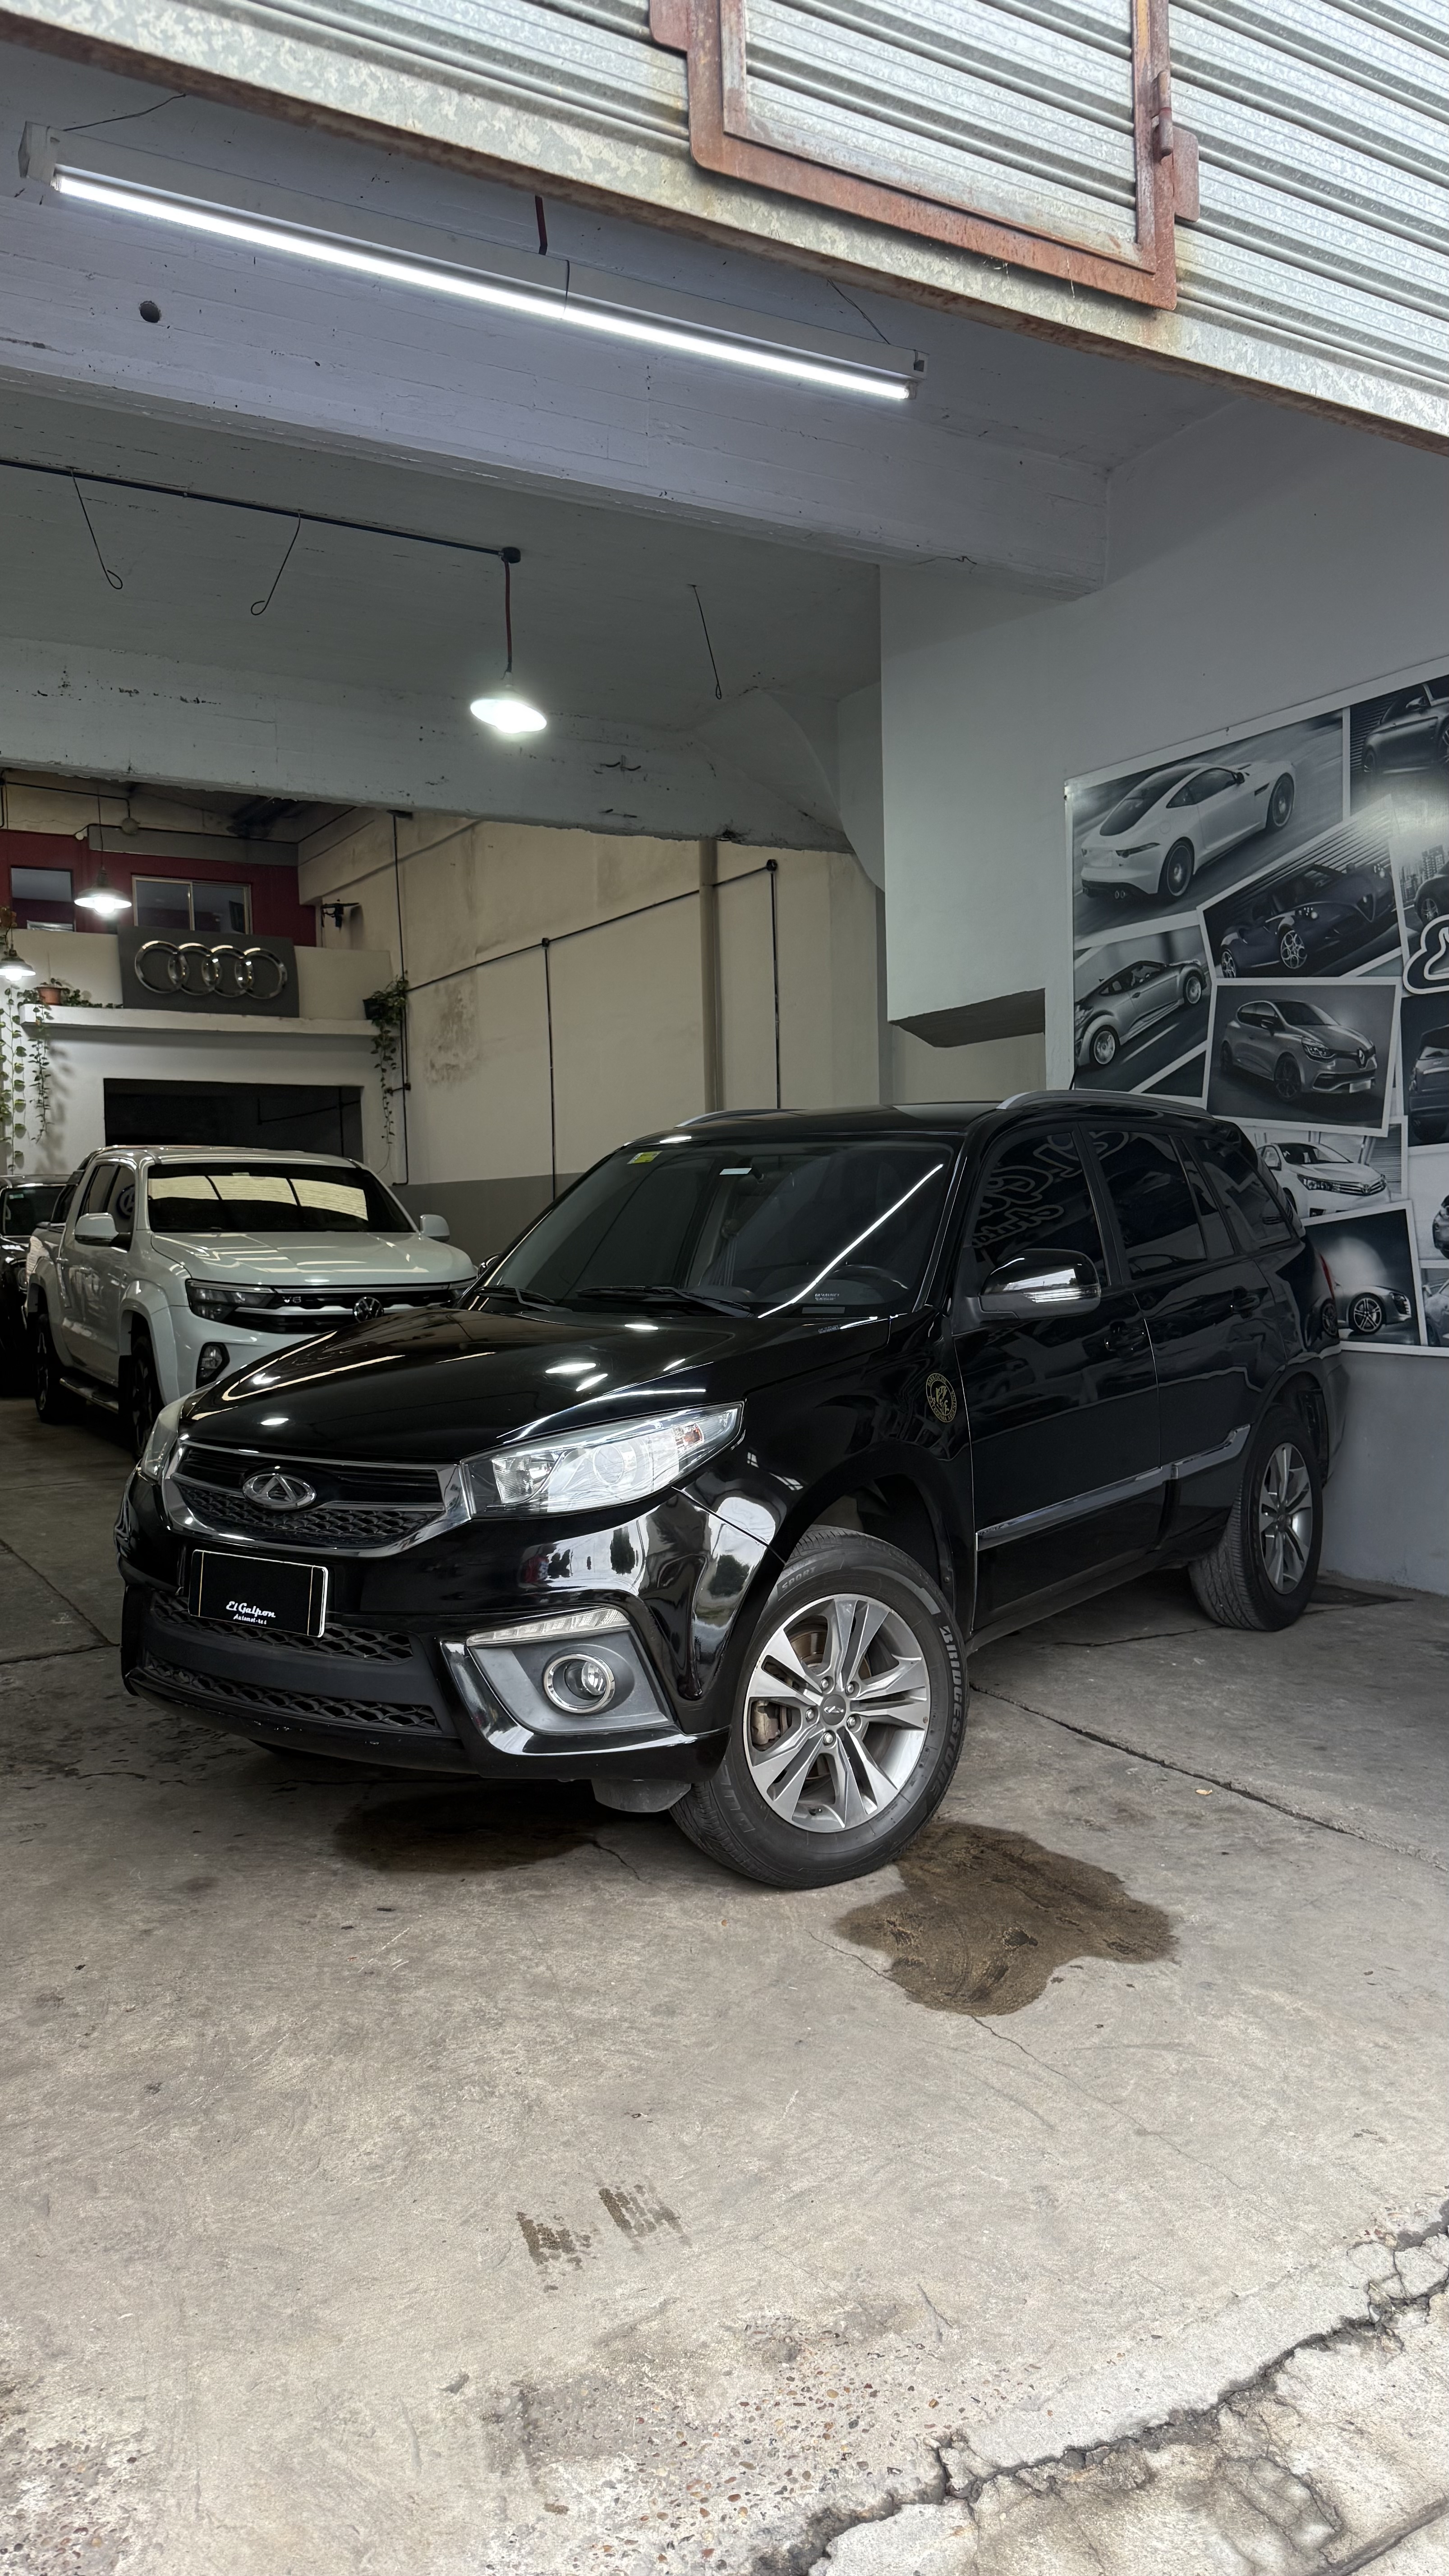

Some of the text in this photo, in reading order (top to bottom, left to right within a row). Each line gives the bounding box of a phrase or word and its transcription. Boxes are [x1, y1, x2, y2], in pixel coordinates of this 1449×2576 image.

[782, 1566, 817, 1592] SPORT
[226, 1601, 238, 1611] El
[930, 1625, 962, 1798] BRIDGESTONE
